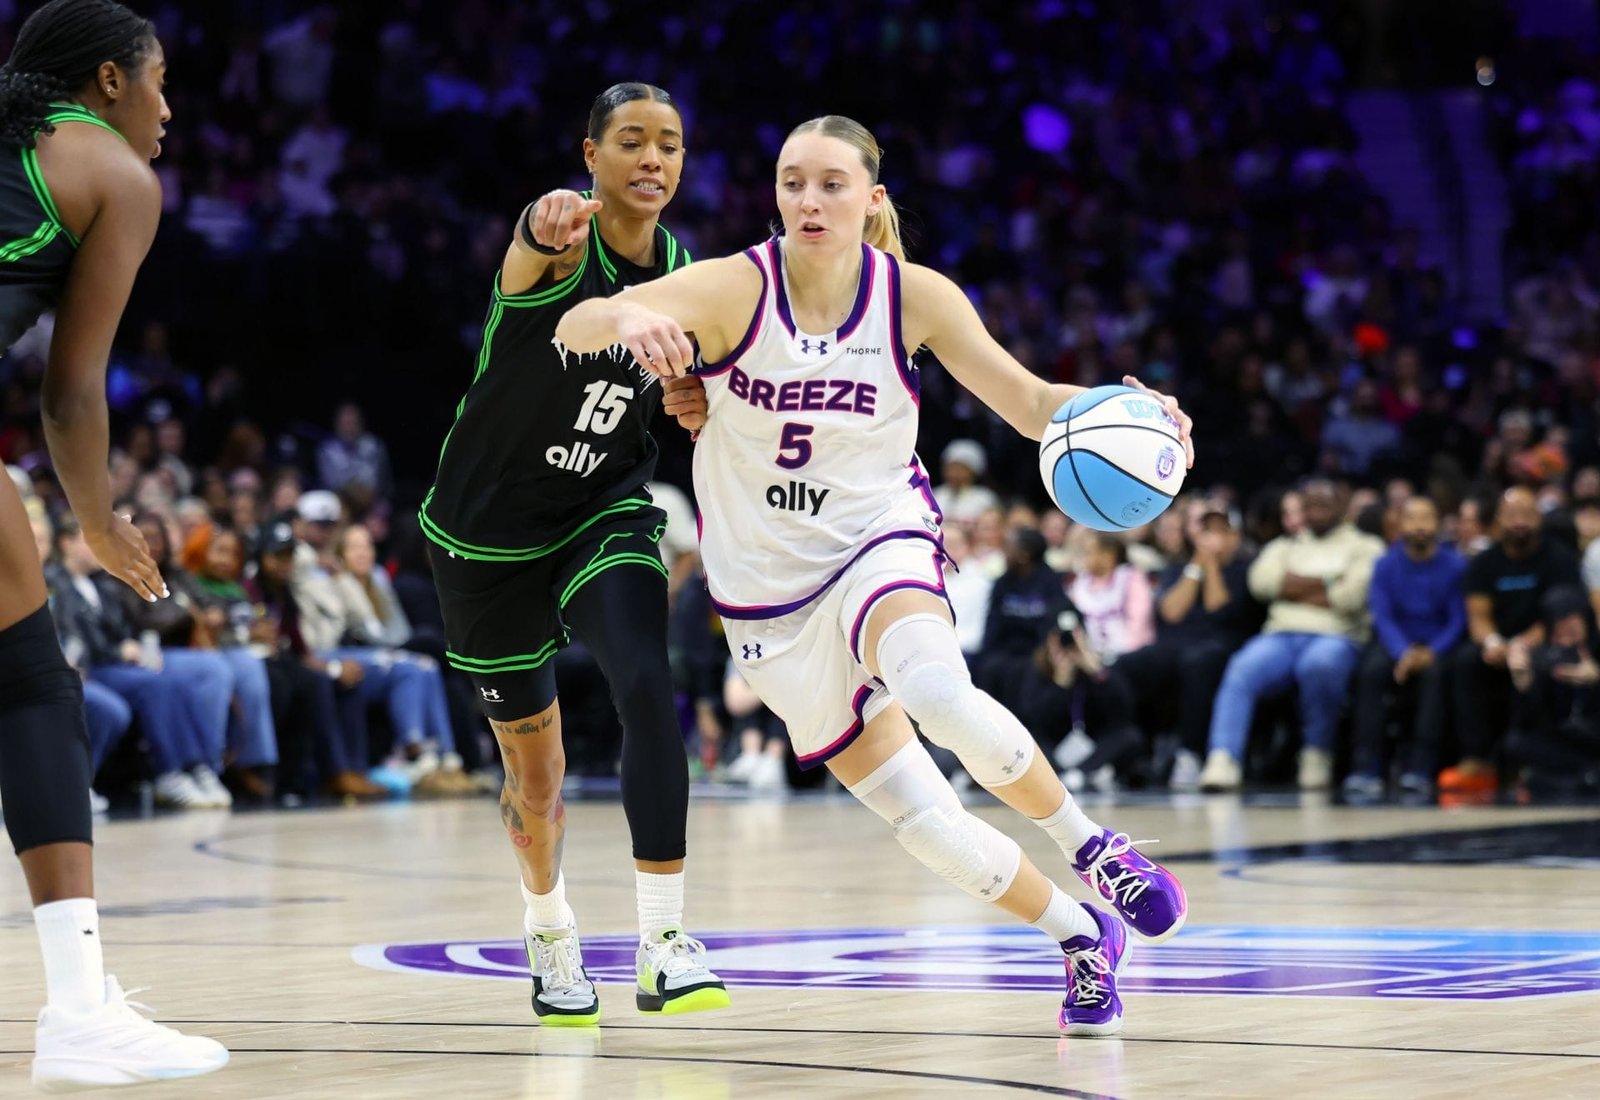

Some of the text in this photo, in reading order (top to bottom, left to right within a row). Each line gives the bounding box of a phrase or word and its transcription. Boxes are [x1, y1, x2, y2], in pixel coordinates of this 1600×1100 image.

[846, 347, 881, 355] THORNE
[573, 379, 634, 435] 15
[728, 365, 877, 416] BREEZE
[545, 441, 608, 478] ally
[775, 422, 814, 470] 5
[766, 481, 830, 516] ally
